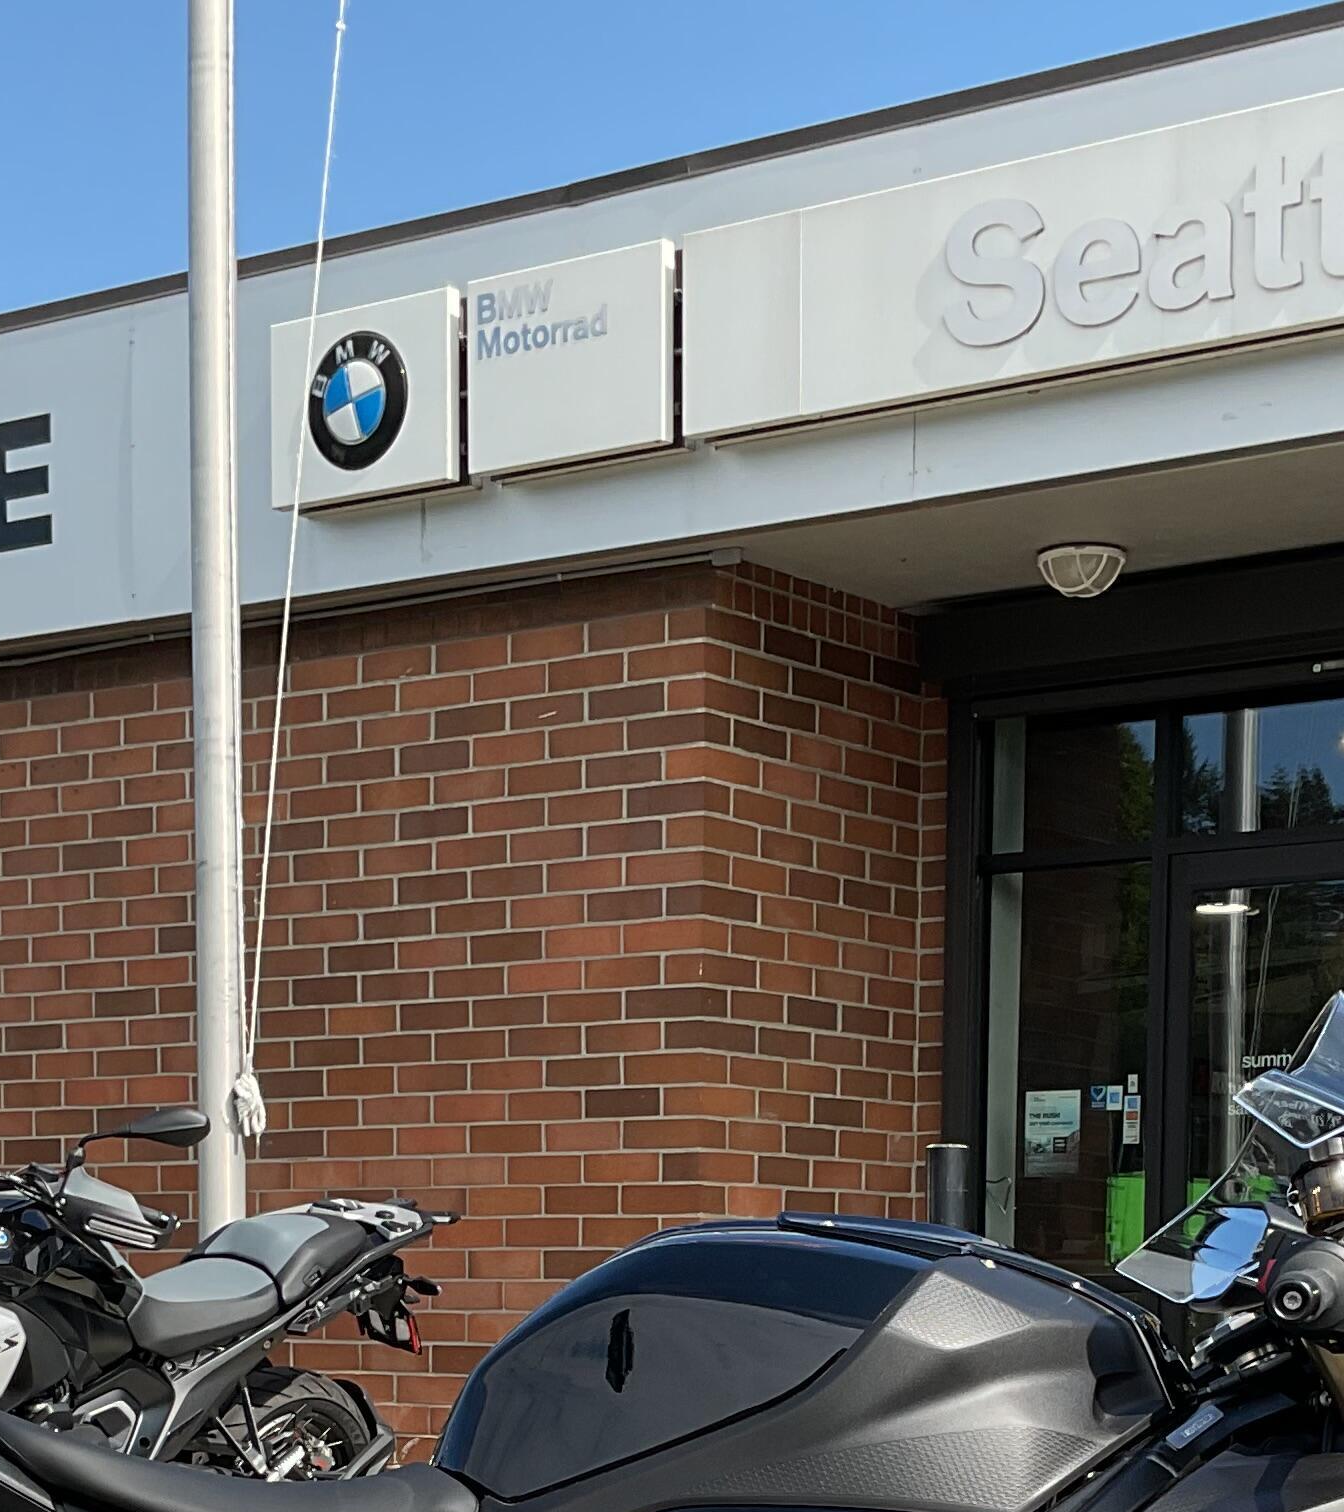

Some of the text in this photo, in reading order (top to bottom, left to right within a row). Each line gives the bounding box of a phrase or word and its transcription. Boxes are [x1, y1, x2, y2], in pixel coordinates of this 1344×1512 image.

[477, 278, 554, 325] BMW
[477, 304, 608, 361] Motorrad
[311, 339, 391, 398] BMW
